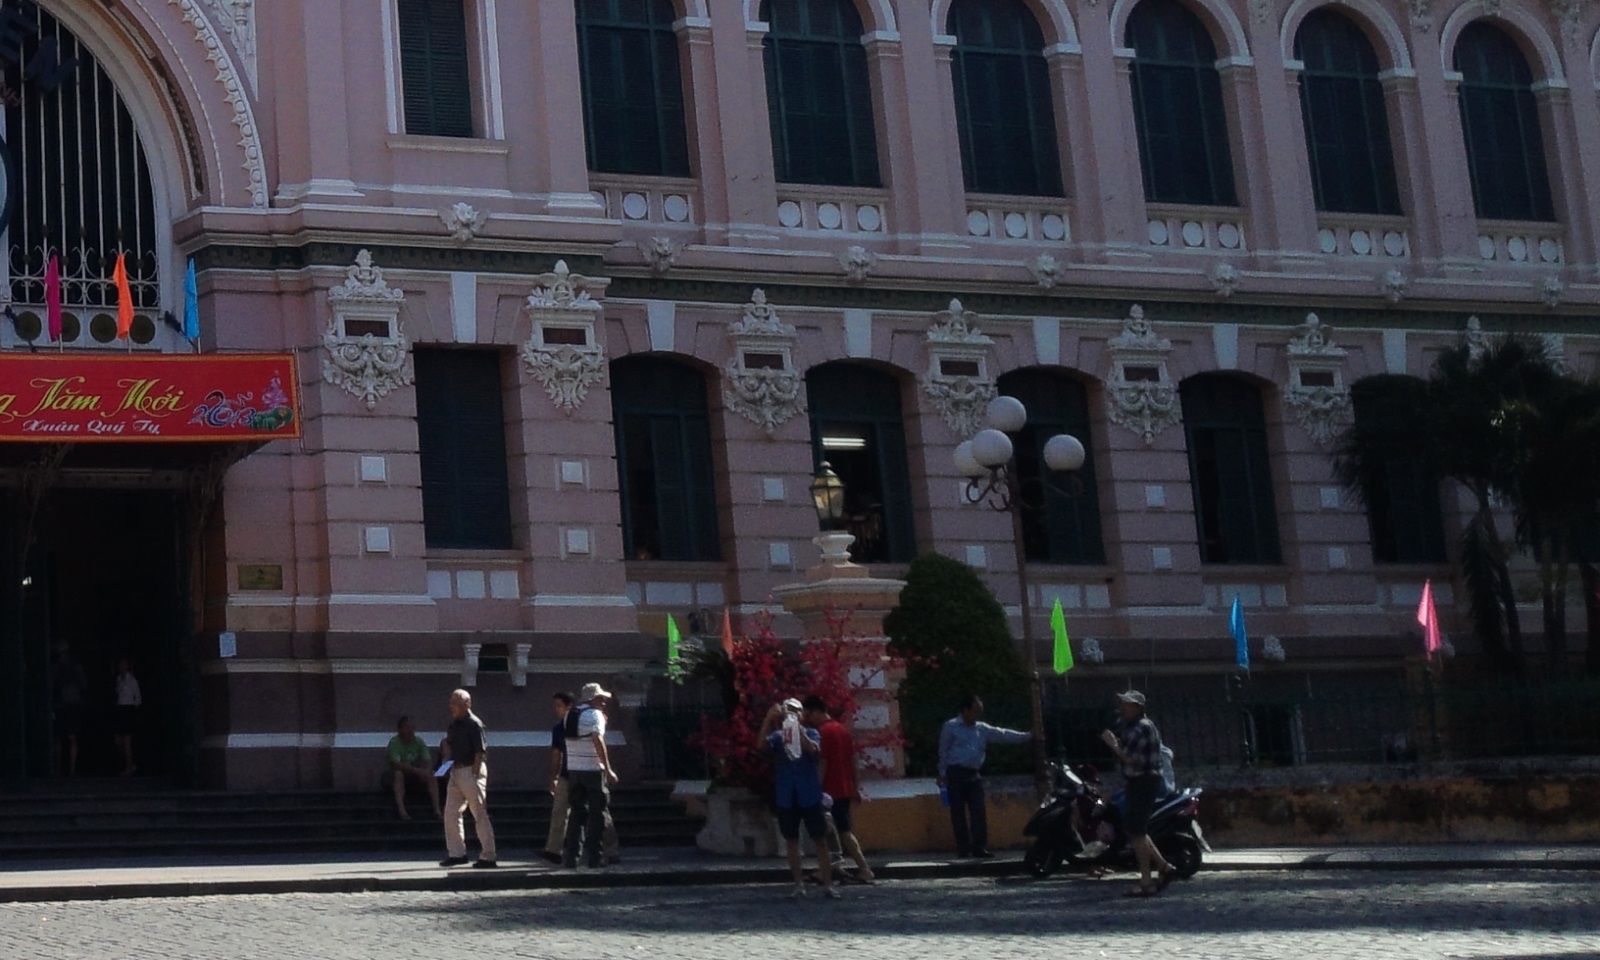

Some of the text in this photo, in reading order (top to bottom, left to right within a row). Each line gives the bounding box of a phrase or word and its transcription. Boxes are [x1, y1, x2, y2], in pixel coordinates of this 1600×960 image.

[13, 376, 100, 417] Năm
[101, 379, 191, 417] Mới
[23, 419, 80, 433] Xuân
